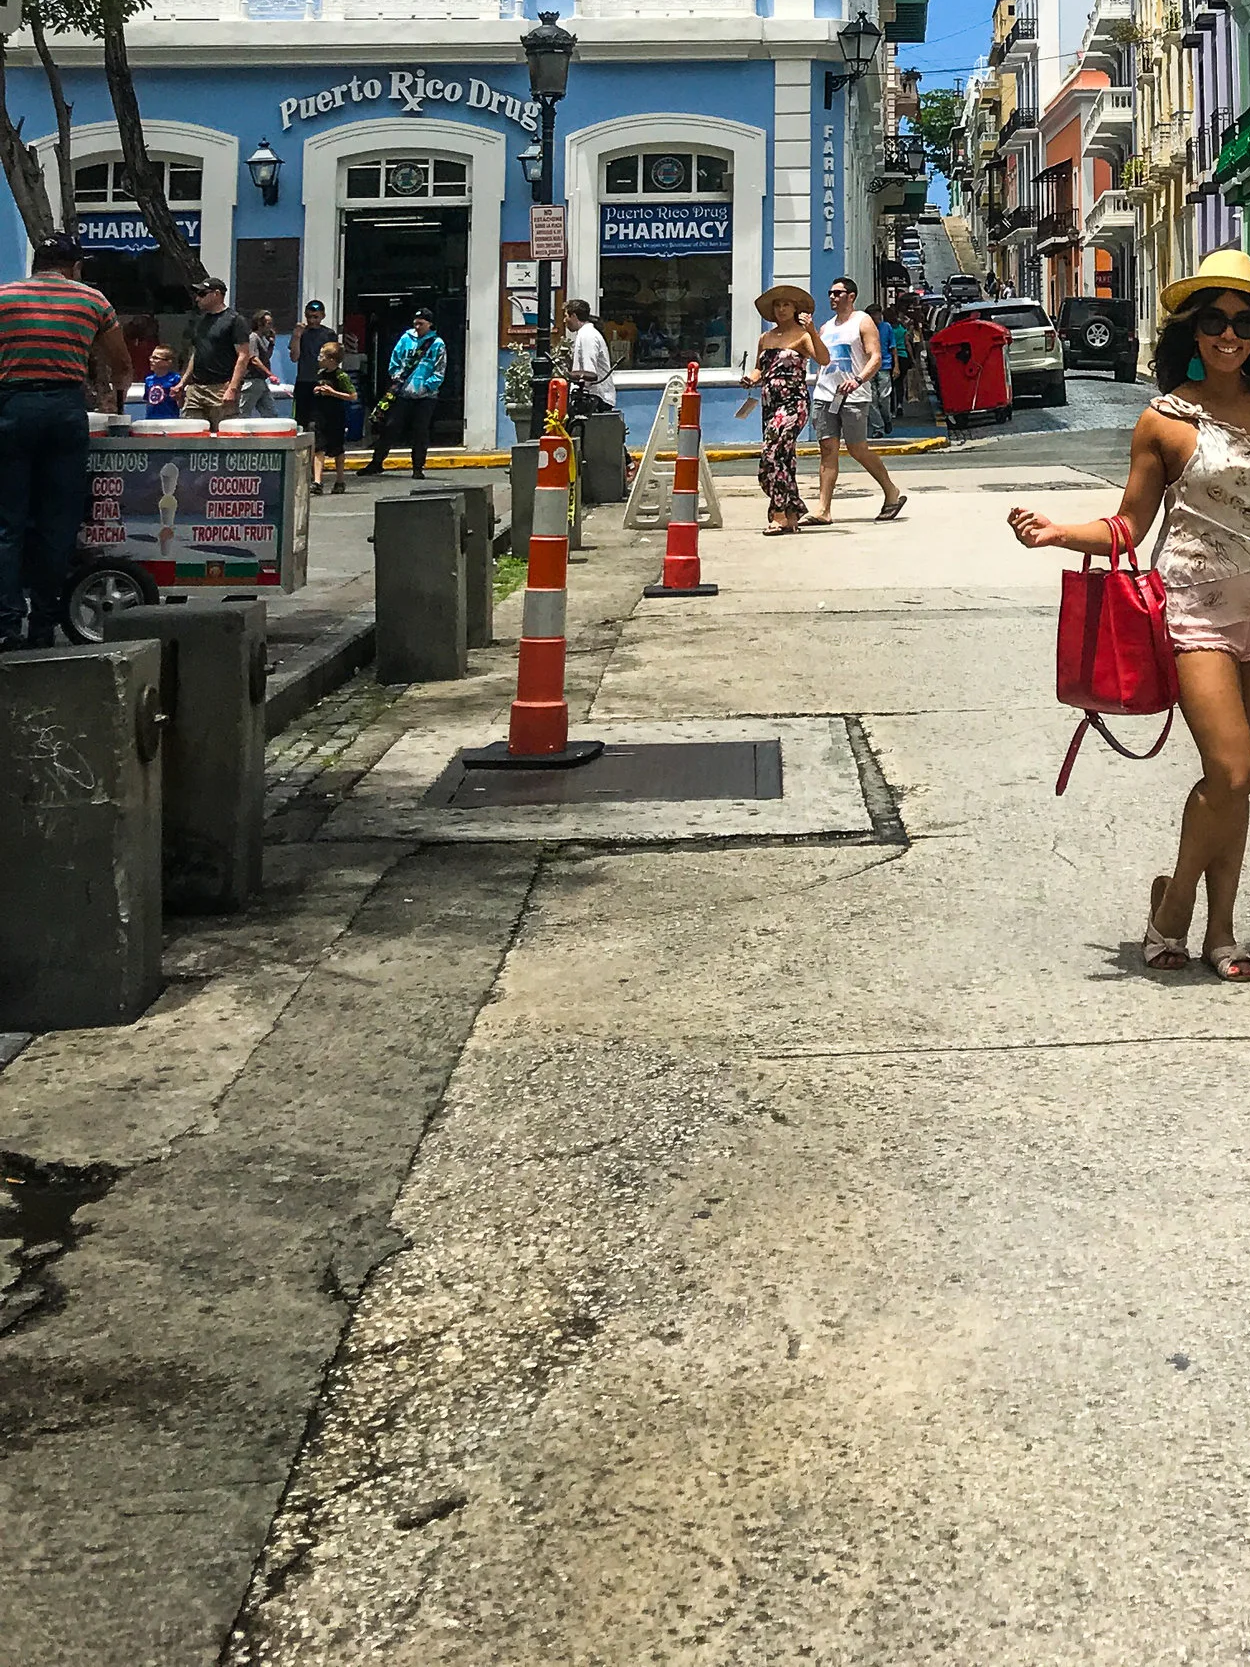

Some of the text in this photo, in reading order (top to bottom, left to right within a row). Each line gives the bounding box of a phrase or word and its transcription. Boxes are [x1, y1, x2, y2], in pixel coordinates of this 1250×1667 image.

[279, 69, 542, 132] Puerto Rico Drug
[823, 125, 835, 250] FARMACIA
[605, 205, 728, 221] Puerto Rico Drug
[78, 220, 199, 239] PHARMY
[604, 221, 729, 240] PHARMACY
[189, 452, 282, 472] ICE CREAM
[92, 477, 124, 496] COCO
[208, 476, 262, 496] COCONUT
[93, 498, 121, 520] PIÑA
[206, 500, 264, 520] PINEAPPLE
[84, 524, 127, 543] PARCHA
[192, 524, 275, 543] TROPICAL FRUIT
